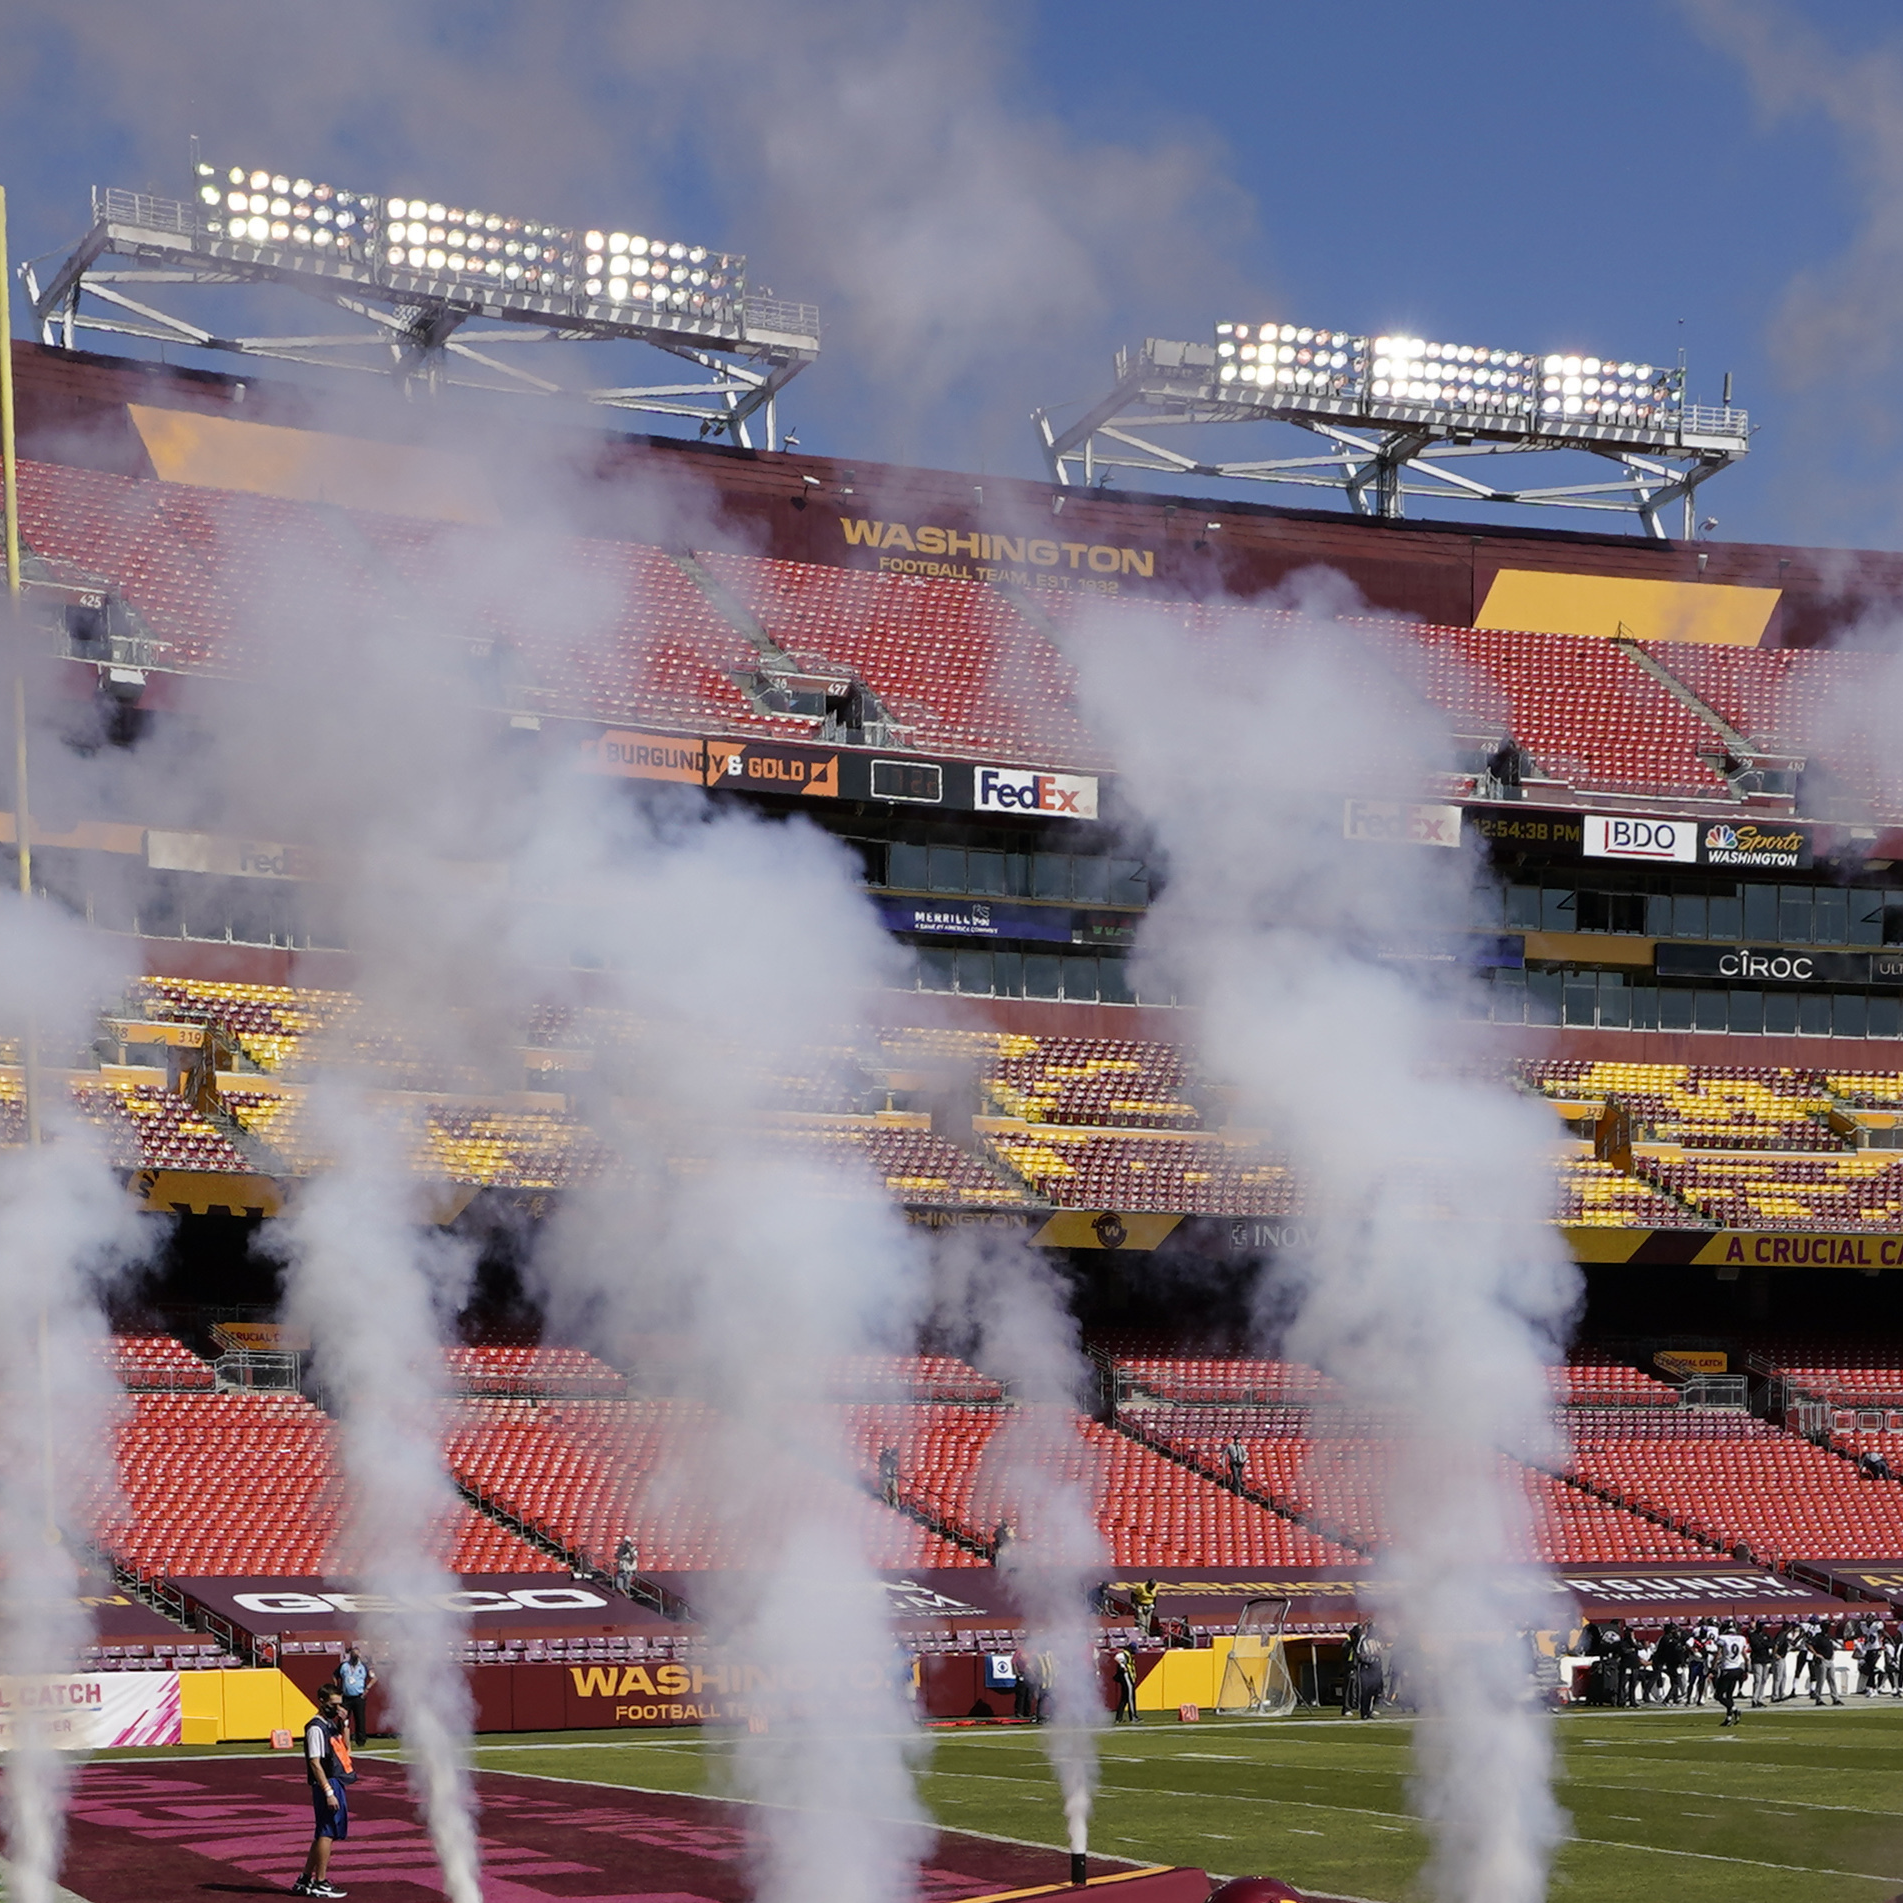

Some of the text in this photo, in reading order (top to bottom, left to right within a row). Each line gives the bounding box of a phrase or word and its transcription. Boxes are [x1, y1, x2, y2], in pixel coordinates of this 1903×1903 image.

[839, 517, 1154, 577] WASHINGTON
[878, 555, 972, 581] FOOTBALL
[827, 683, 847, 696] 427
[605, 742, 804, 782] BURGUNDY & GOLD
[981, 771, 1079, 813] FedEx
[1345, 799, 1446, 841] FedEx
[1553, 824, 1581, 841] PM
[1614, 822, 1675, 849] BDO
[1736, 826, 1804, 854] Sports
[1707, 850, 1798, 867] WASHINGTON
[915, 911, 970, 925] MERRILL
[1719, 949, 1813, 979] CÎROC
[179, 1030, 202, 1044] 319
[1725, 1236, 1745, 1262] A
[1754, 1238, 1871, 1265] CRUCIAL
[233, 1588, 608, 1614] GECO
[1592, 1588, 1813, 1602] THANKS ALL THE
[1729, 1642, 1739, 1661] 9
[616, 1705, 720, 1722] FOOTBALL
[1182, 1705, 1198, 1721] 20
